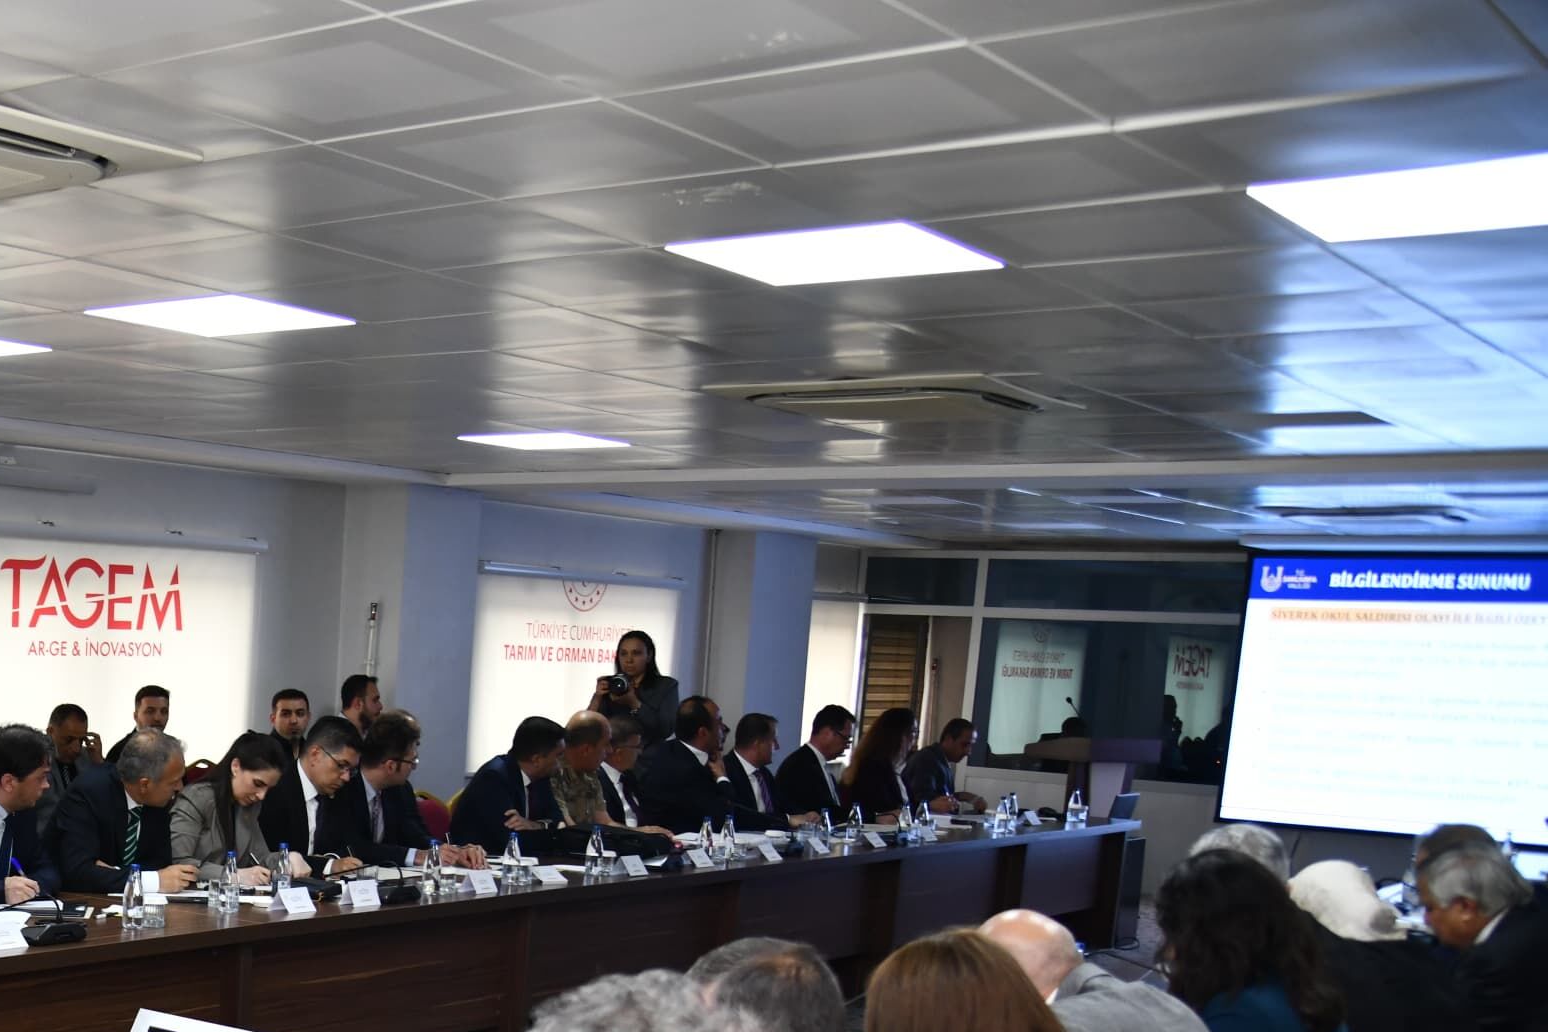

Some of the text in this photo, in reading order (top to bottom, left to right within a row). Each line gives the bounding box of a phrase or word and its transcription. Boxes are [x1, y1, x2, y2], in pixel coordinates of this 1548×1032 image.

[1329, 570, 1456, 589] BİLGİLENDİRME
[1457, 573, 1533, 591] SUNUMU
[0, 555, 183, 632] TAGEM
[526, 620, 567, 640] TÜRKİYE
[28, 637, 162, 656] AR-GE & İNOVASYON
[504, 645, 537, 661] TARIM
[540, 646, 554, 662] VE
[556, 647, 594, 663] ORMAN
